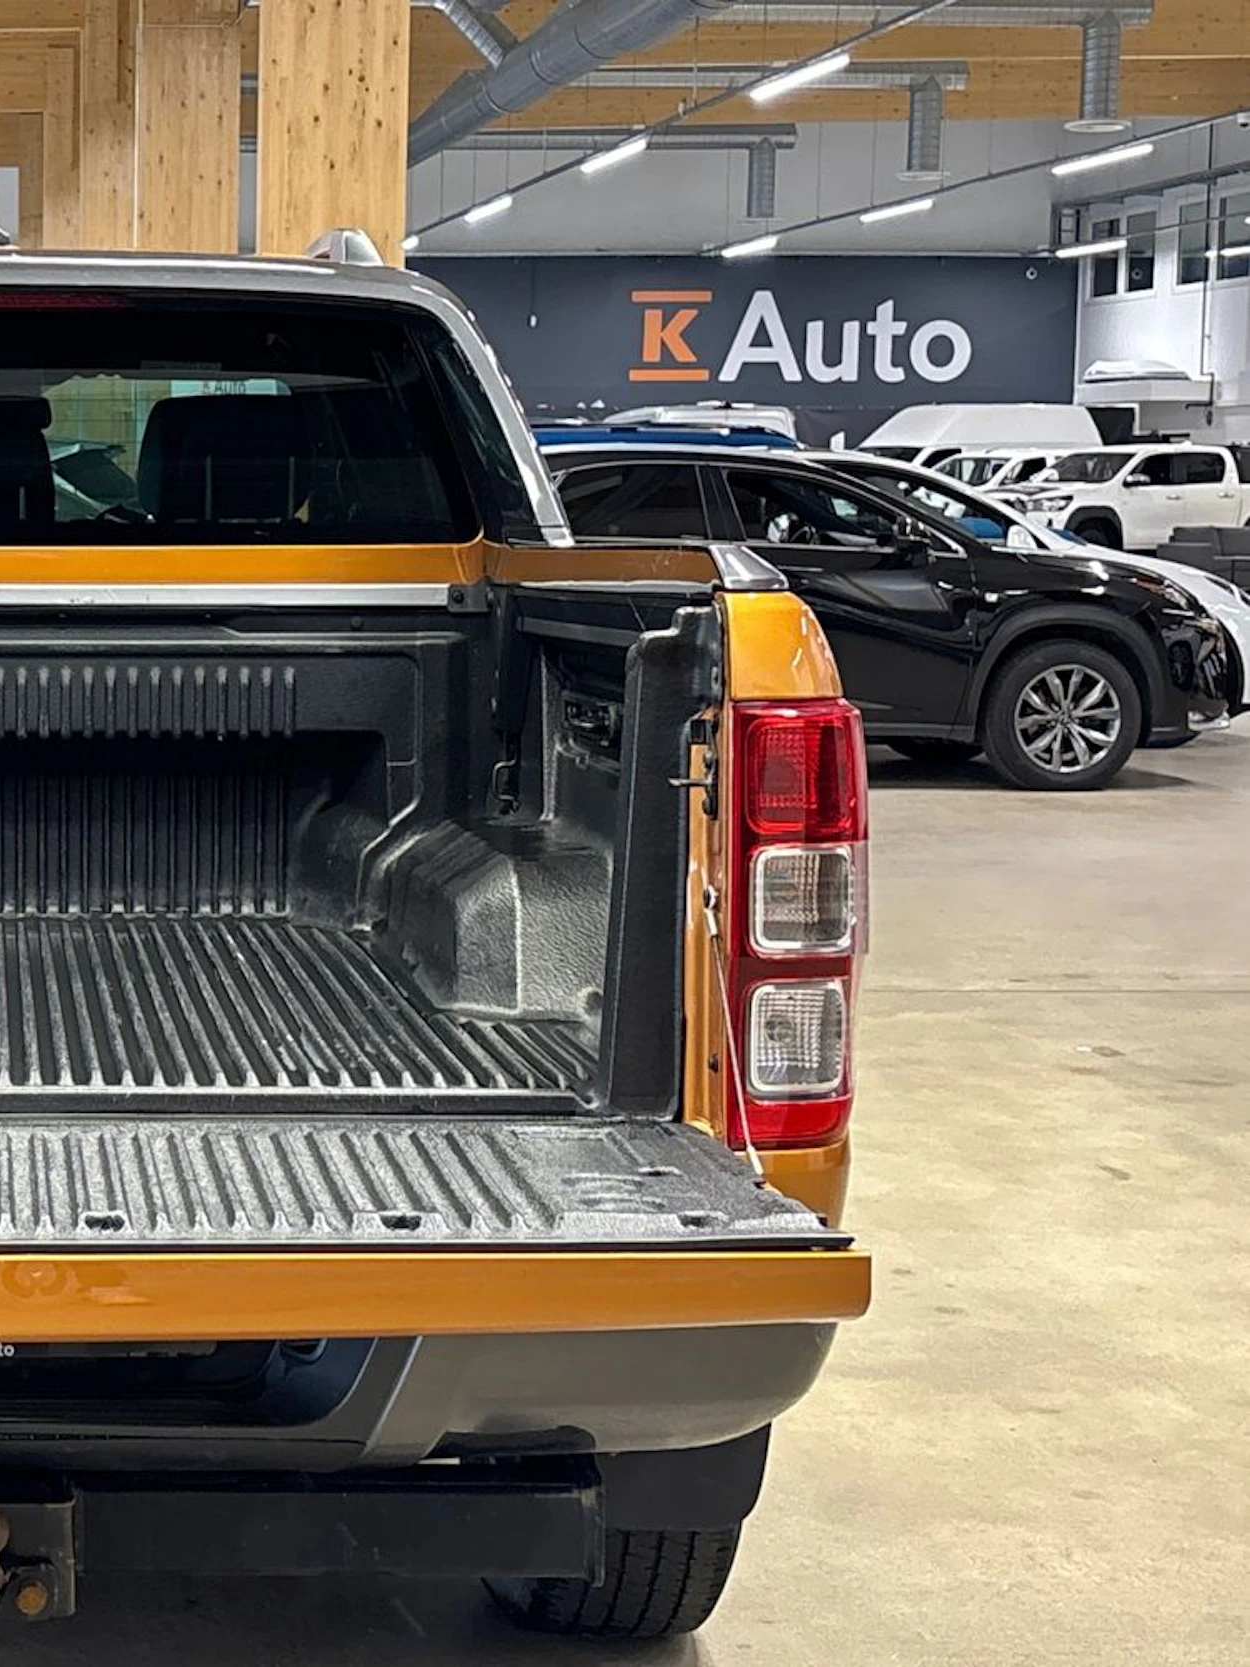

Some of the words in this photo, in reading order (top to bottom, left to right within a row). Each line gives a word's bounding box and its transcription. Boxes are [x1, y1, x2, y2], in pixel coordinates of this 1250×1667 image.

[642, 308, 698, 363] K
[718, 290, 972, 383] Auto
[214, 380, 247, 395] Auto
